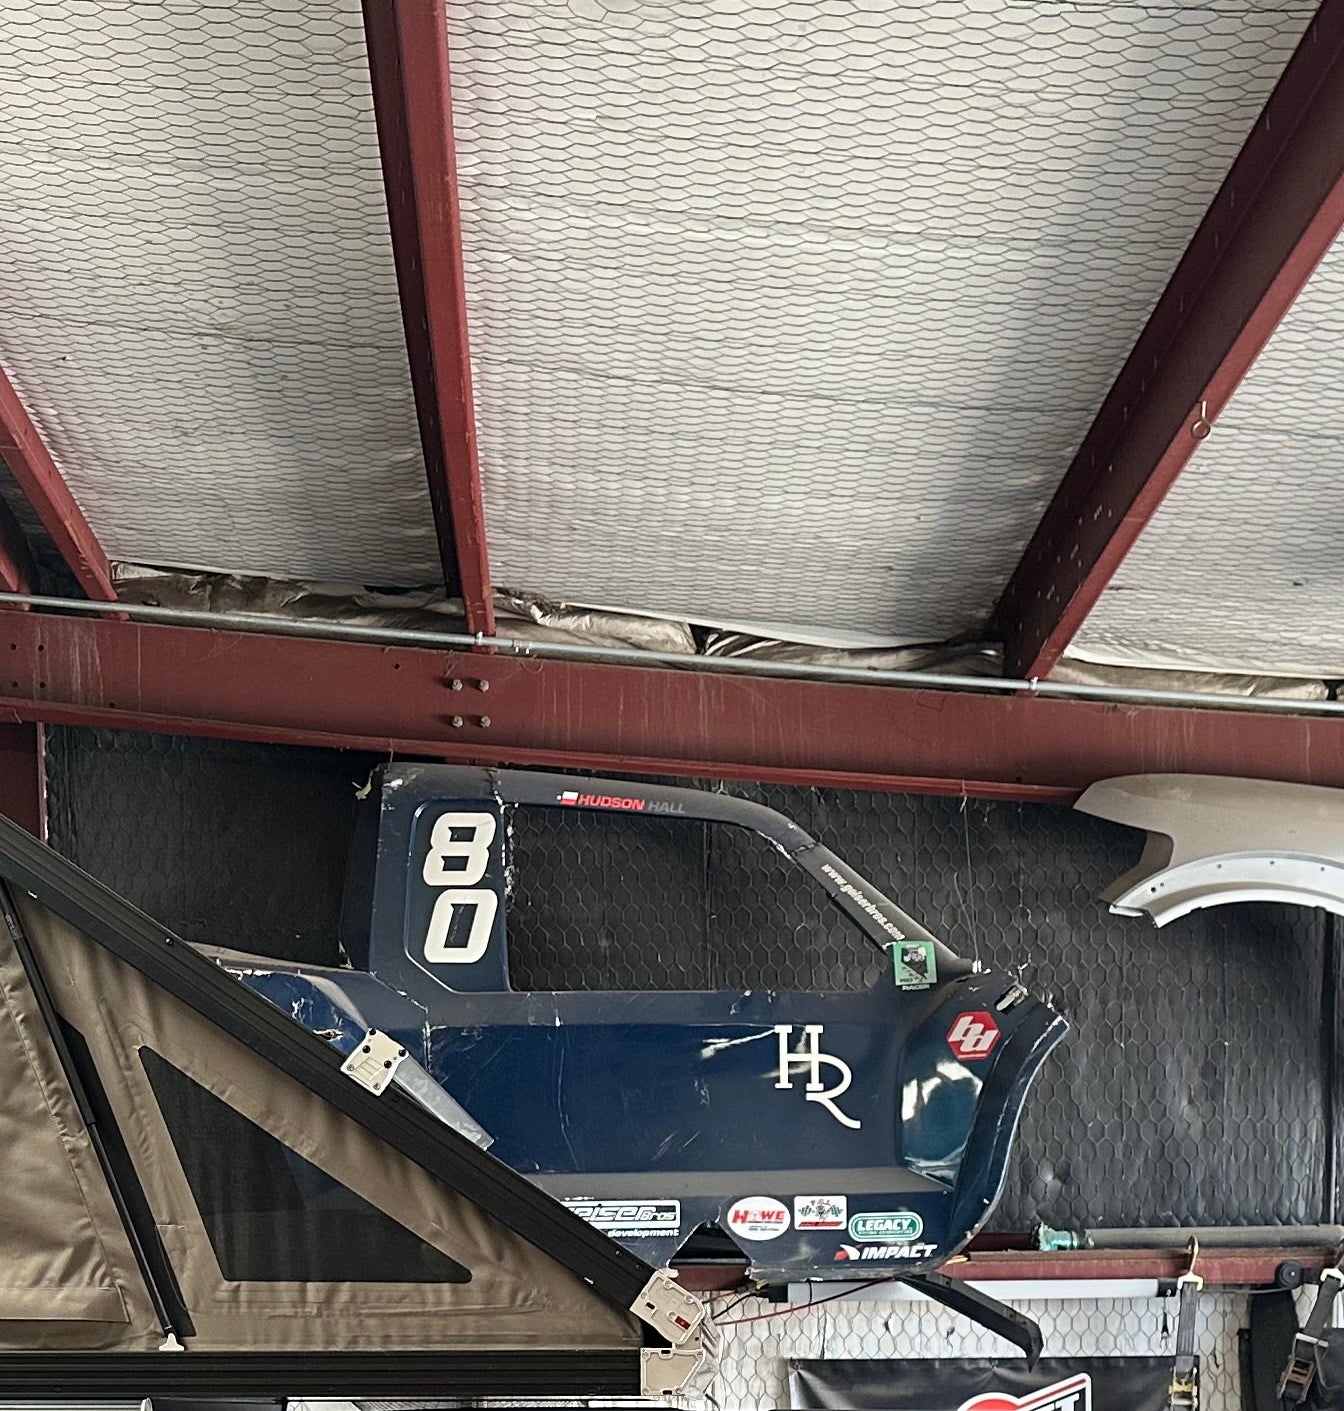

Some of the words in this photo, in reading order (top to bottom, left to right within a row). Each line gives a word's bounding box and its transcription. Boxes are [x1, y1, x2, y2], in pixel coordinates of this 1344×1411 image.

[578, 794, 646, 811] HUDSON
[648, 800, 685, 813] HALL
[423, 812, 498, 963] 80
[857, 1218, 912, 1231] LEGACY
[607, 1229, 680, 1238] development
[861, 1244, 938, 1260] IMPACT
